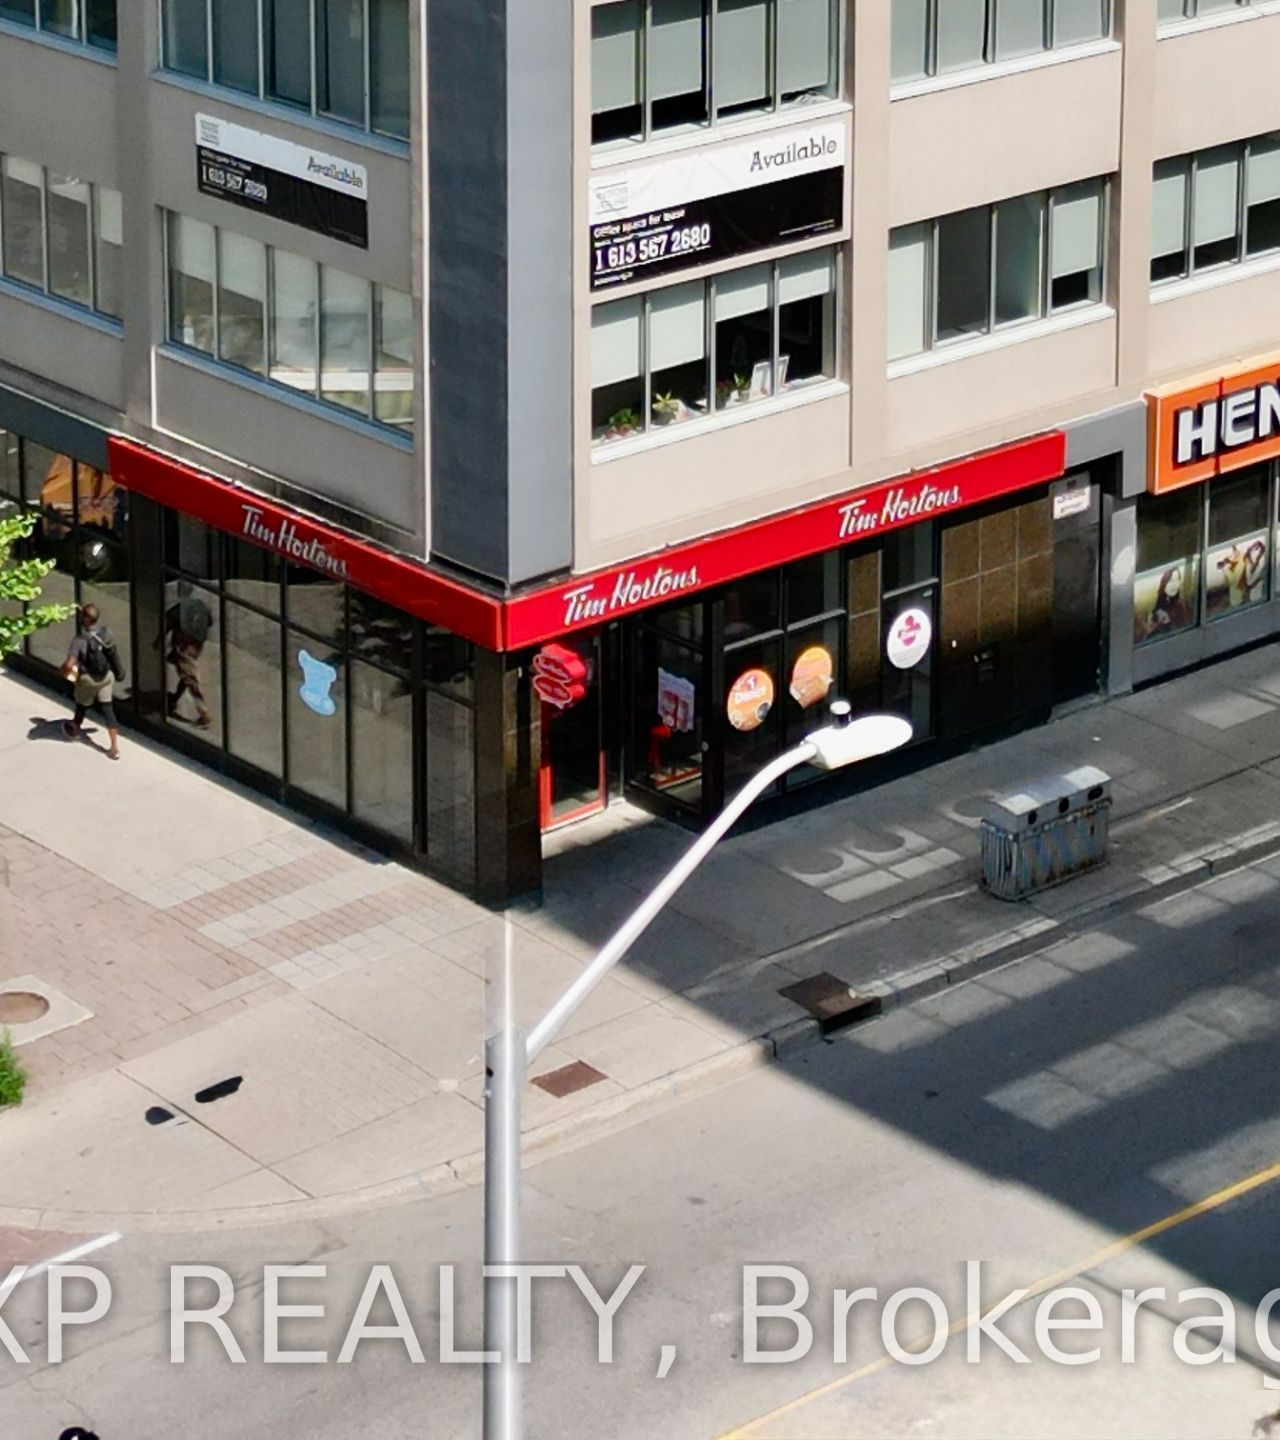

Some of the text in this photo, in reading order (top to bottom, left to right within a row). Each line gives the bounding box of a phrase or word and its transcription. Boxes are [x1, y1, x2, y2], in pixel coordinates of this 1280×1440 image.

[749, 135, 837, 173] Available
[595, 249, 604, 271] 1
[607, 242, 637, 268] 613
[639, 233, 669, 261] 567
[670, 223, 711, 253] 2680
[837, 484, 960, 538] Tim Hortons
[241, 503, 348, 578] Tim Hortons
[562, 565, 697, 626] Tim Hortons
